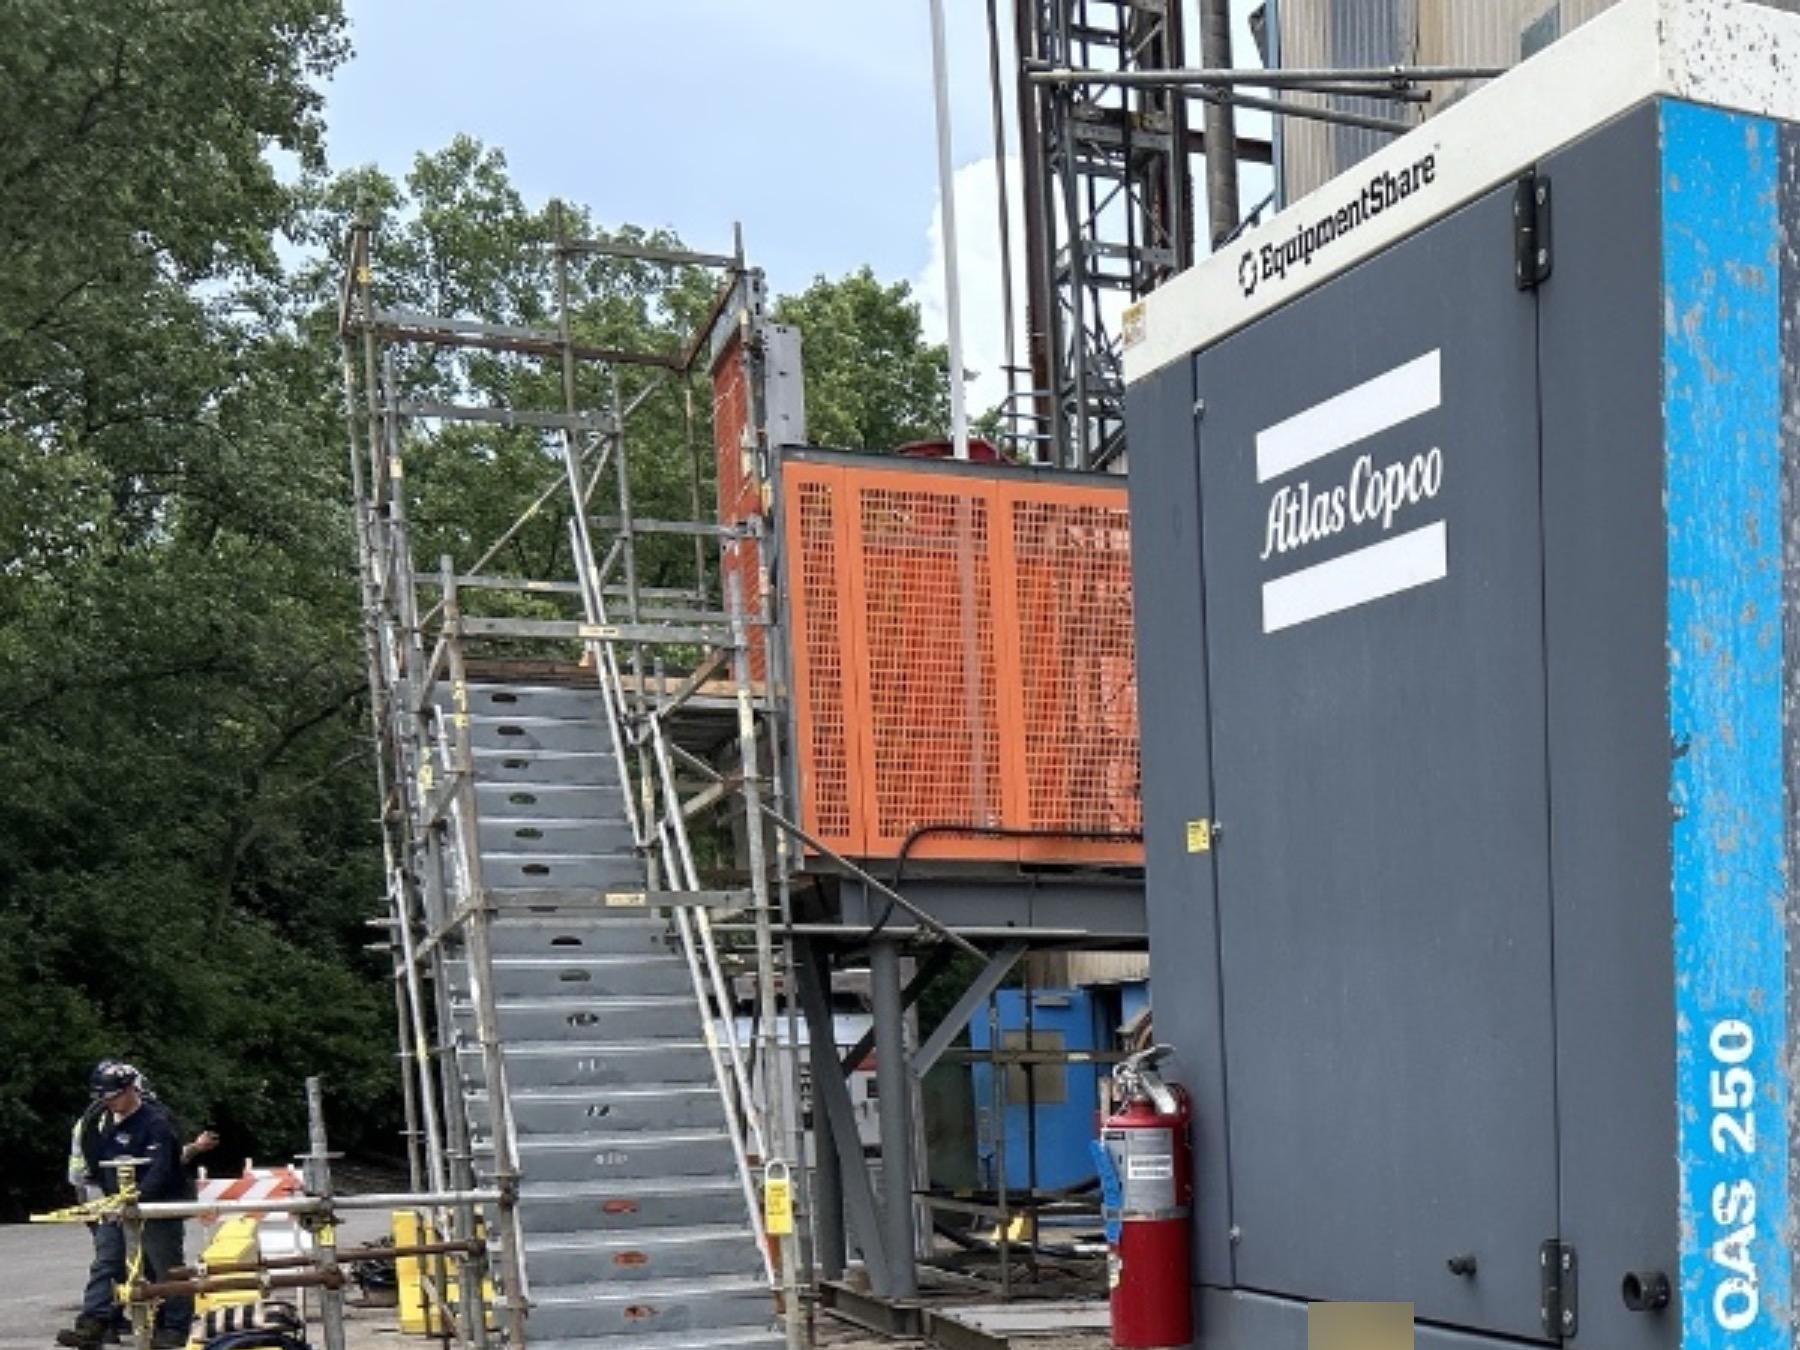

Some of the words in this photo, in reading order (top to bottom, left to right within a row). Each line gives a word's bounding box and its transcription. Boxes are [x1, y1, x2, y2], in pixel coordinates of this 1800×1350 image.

[1260, 153, 1436, 280] EquipmentShare
[1260, 479, 1346, 562] Atlas
[1350, 446, 1443, 530] Copco
[1709, 1018, 1756, 1155] 250
[1711, 1178, 1760, 1331] QAS
